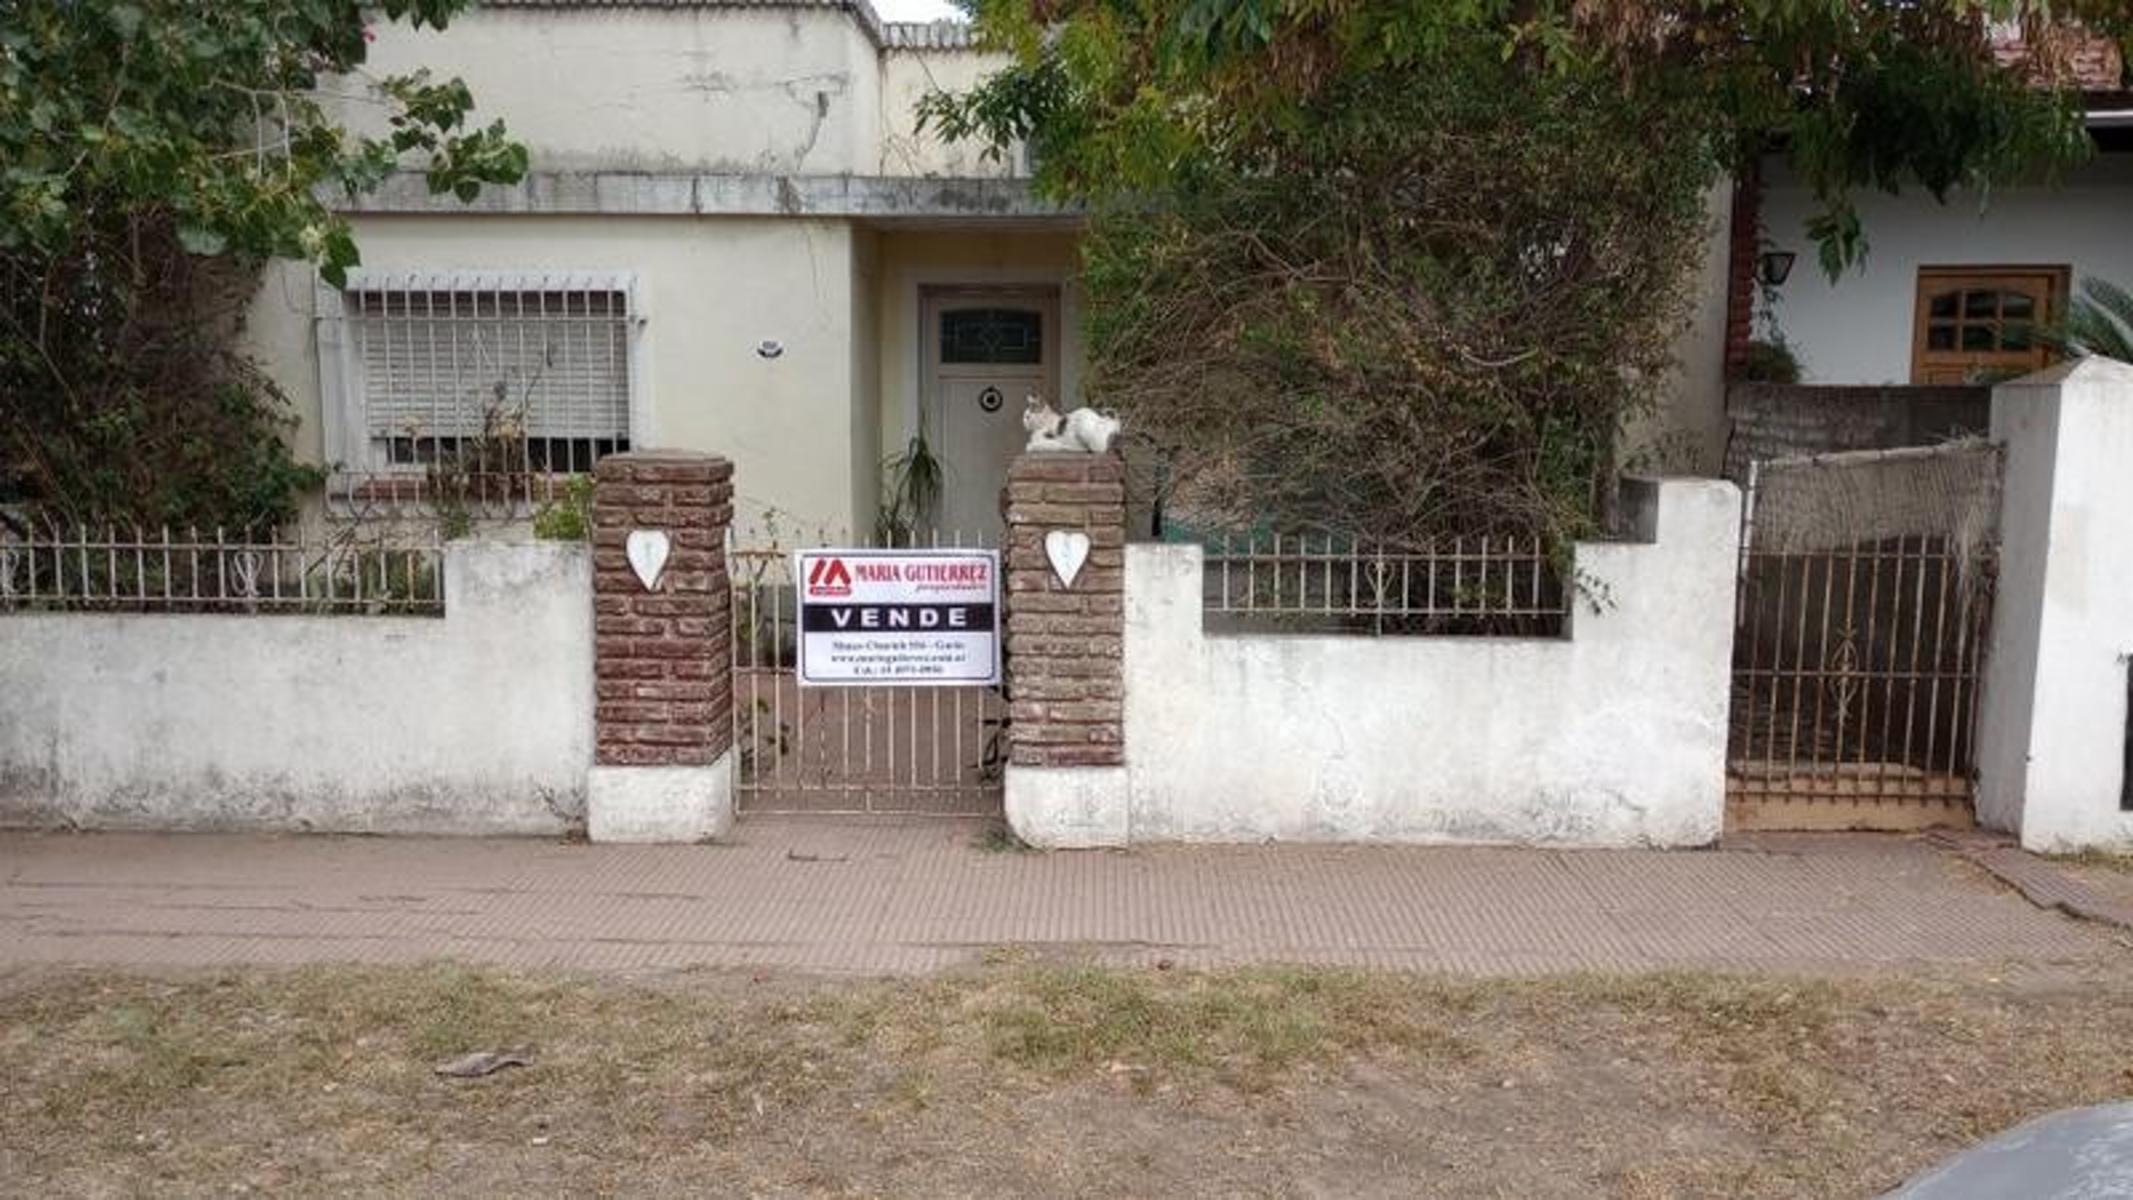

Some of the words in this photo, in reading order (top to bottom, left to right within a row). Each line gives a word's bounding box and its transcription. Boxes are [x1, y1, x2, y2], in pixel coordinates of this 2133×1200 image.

[856, 565, 900, 582] MARIA
[905, 564, 987, 582] GUTIERREZ
[831, 608, 967, 627] VENDE
